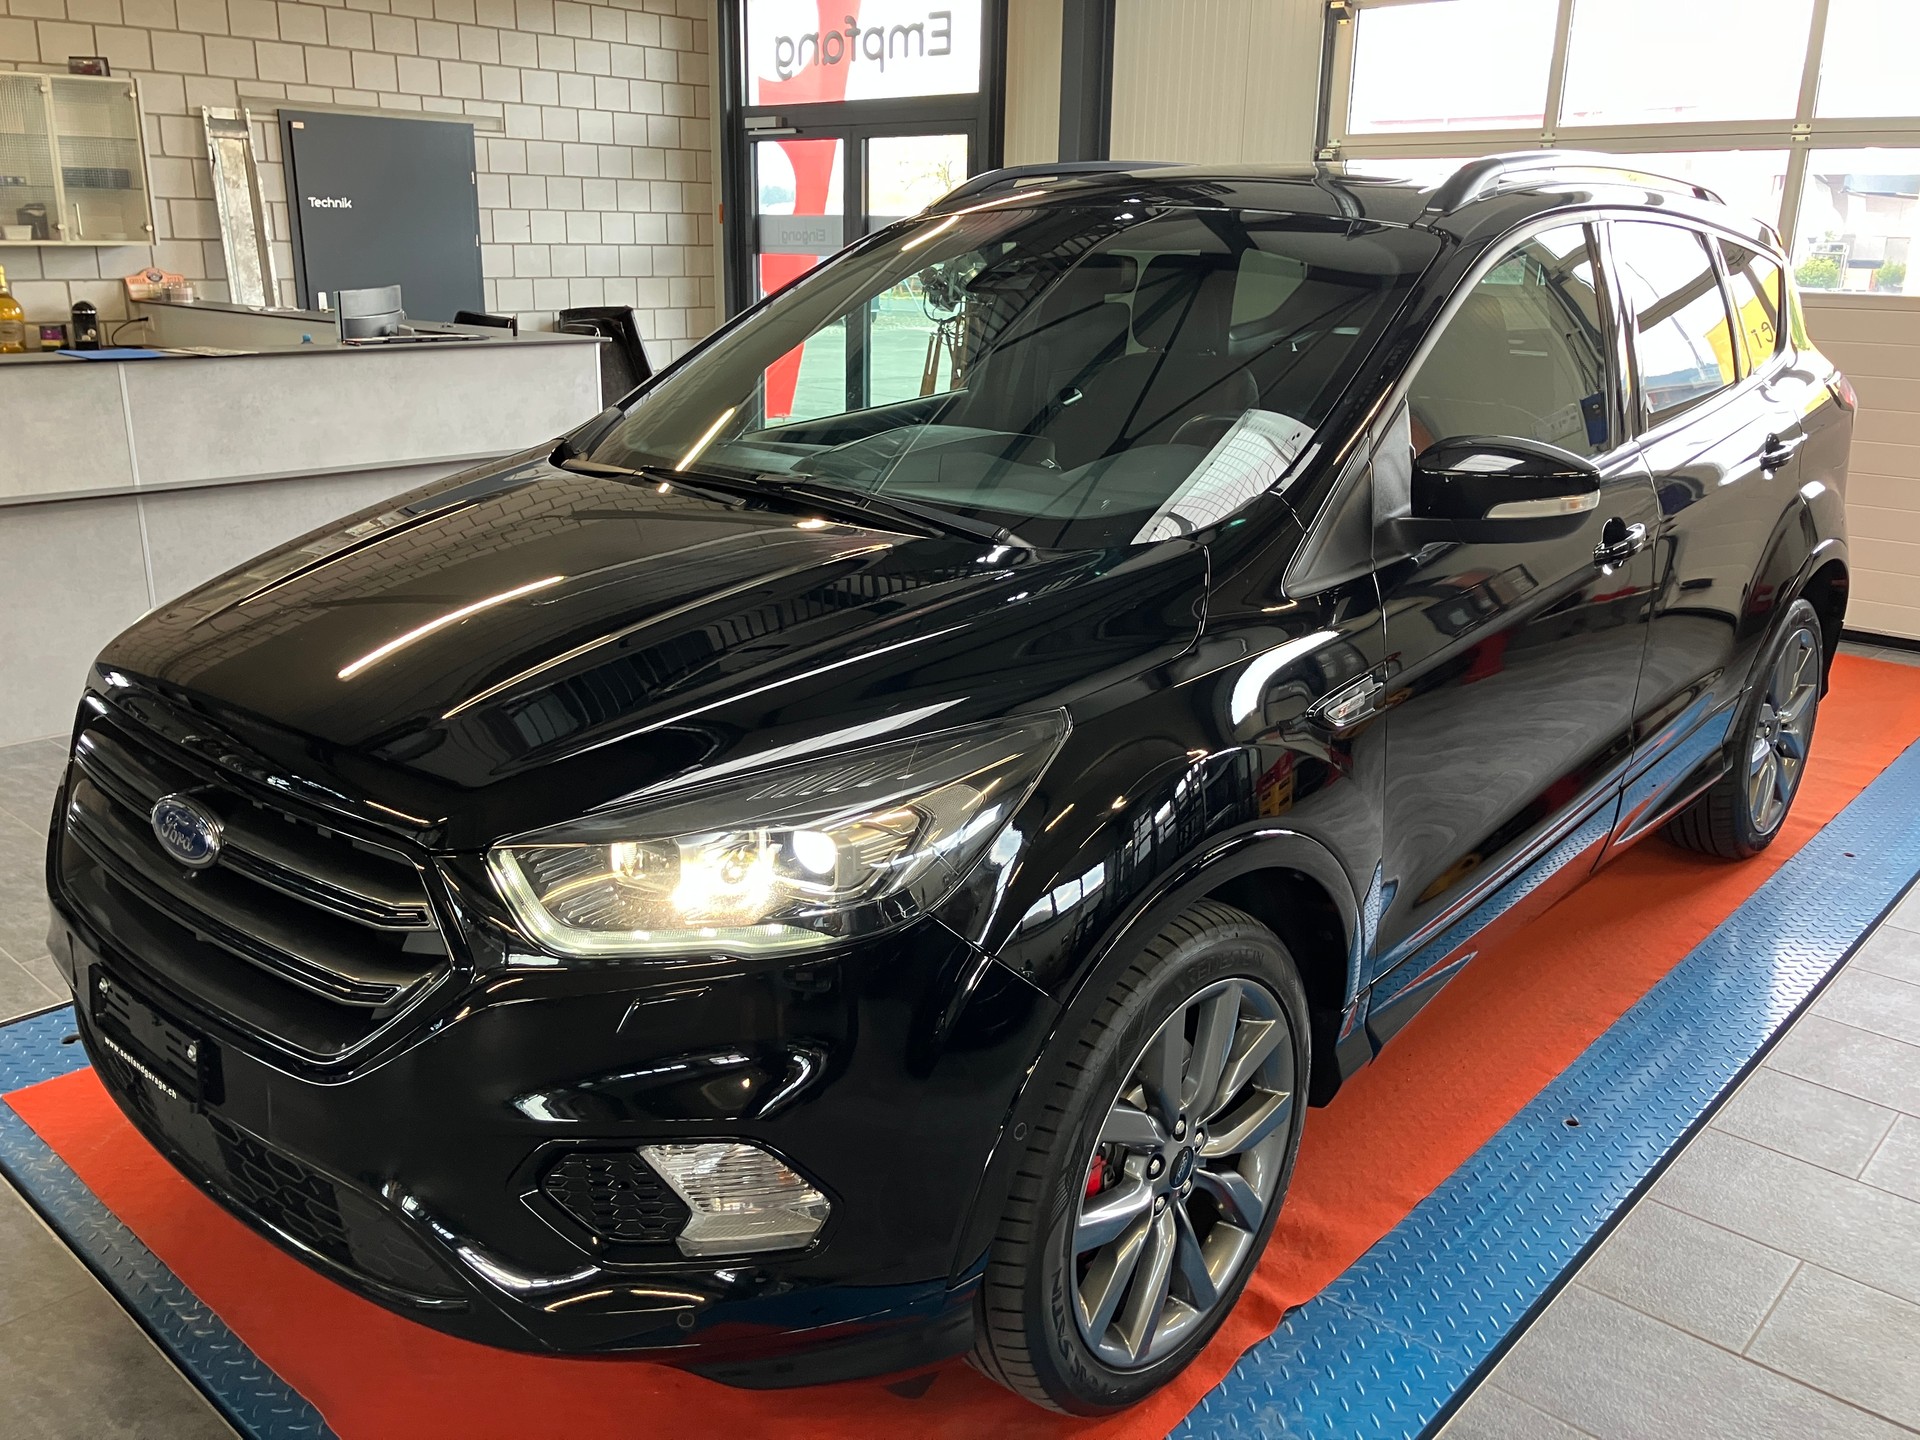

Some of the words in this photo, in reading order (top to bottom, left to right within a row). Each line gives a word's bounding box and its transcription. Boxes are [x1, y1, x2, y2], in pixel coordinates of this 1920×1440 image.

[307, 196, 353, 209] Technik
[161, 811, 197, 852] Ford
[104, 1036, 177, 1100] www.seelandgarage.ch
